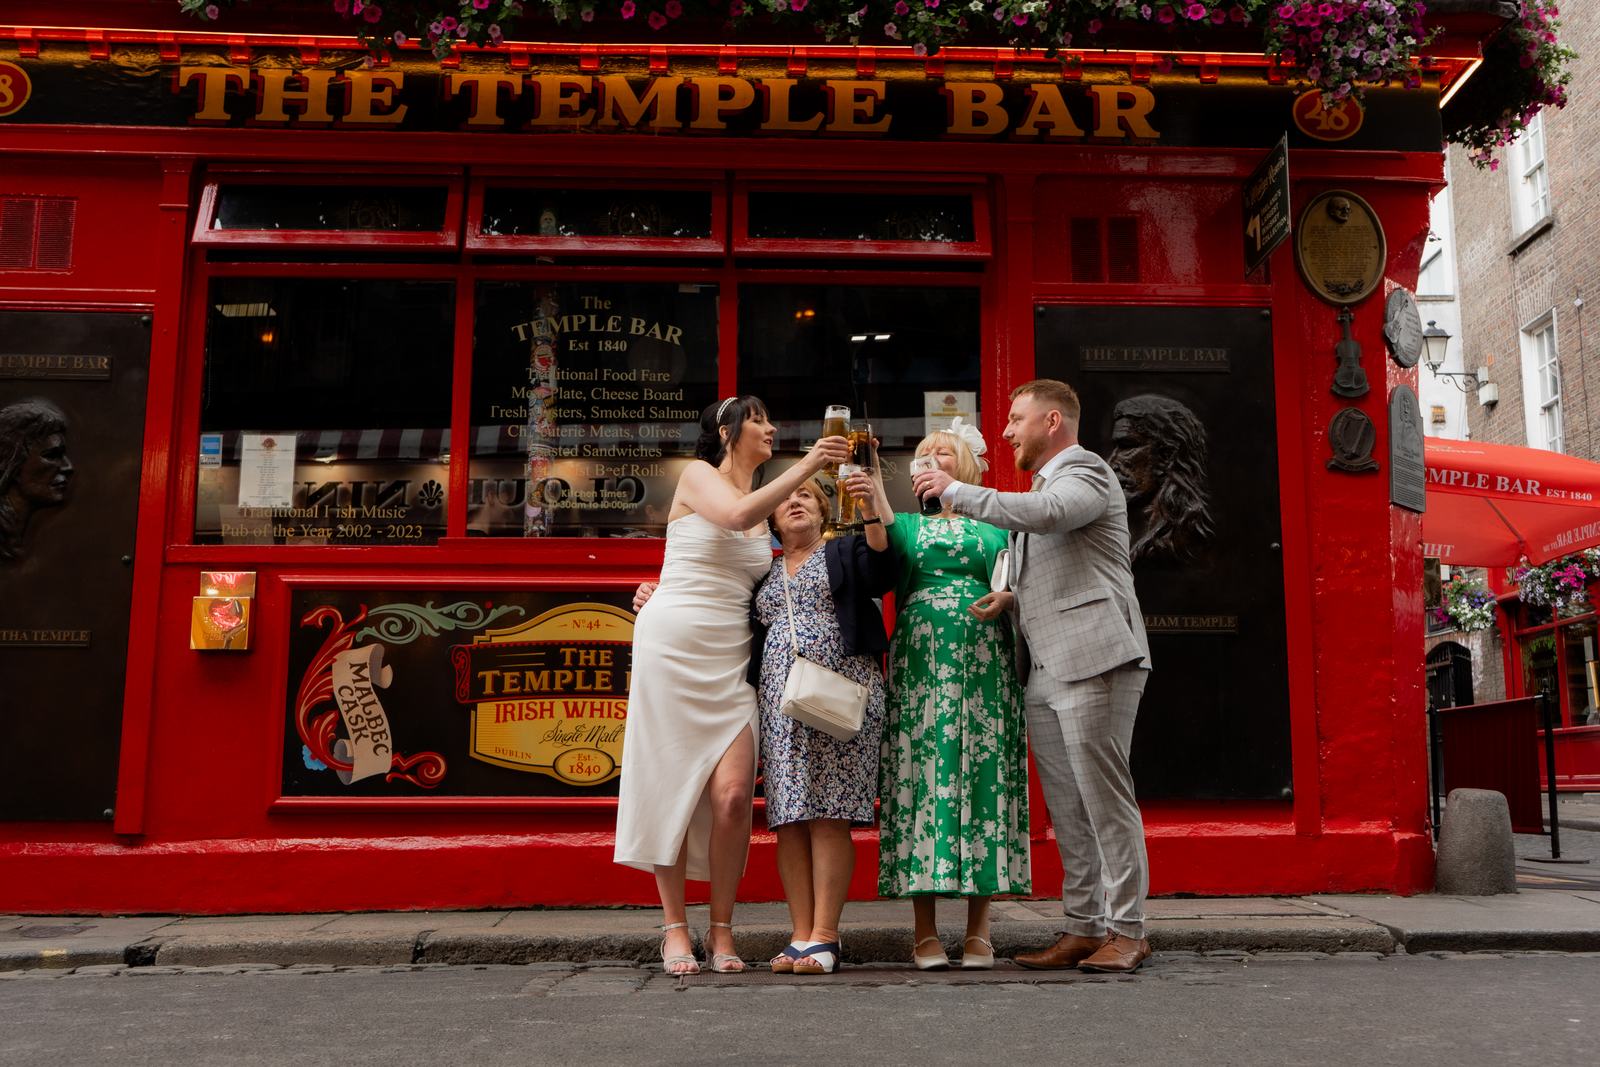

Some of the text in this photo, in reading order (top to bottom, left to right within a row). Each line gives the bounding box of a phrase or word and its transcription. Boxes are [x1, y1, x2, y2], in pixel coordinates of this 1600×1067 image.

[0, 74, 14, 107] 8
[176, 66, 1161, 139] THE TEMPLE BAR
[1304, 97, 1350, 130] 48
[581, 295, 612, 310] The
[511, 314, 684, 346] TEMPLE BAR
[568, 339, 628, 352] Est 1840
[1085, 348, 1228, 361] THE TEMPLE BAR
[73, 356, 109, 369] BAR
[525, 367, 671, 382] Titional Food Fare
[591, 387, 639, 400] Cheese
[643, 388, 684, 401] Board
[591, 406, 645, 419] Smoked
[649, 406, 700, 420] Salmon
[507, 424, 682, 439] Chcuterie Meats, Olives
[583, 444, 663, 458] Sandwiches
[630, 464, 665, 478] Rolls
[1424, 467, 1593, 501] MPLE BAR EST 1840
[599, 488, 628, 499] Times
[241, 504, 406, 519] Traditional Iish Music
[220, 524, 251, 538] Pub
[254, 524, 272, 538] of
[273, 524, 296, 538] the
[299, 524, 332, 539] Year
[336, 524, 372, 539] 2002
[386, 524, 423, 539] 2023
[1145, 616, 1236, 628] LIAM TEMPLE
[1, 630, 89, 641] THA TEMPLE
[559, 647, 614, 667] THE
[477, 670, 614, 696] TEMPLE
[338, 685, 370, 745] CASK
[349, 662, 390, 757] MALBEC
[494, 701, 628, 724] IRISH WHIS
[539, 720, 585, 747] Single
[494, 746, 533, 760] DUBLIN
[569, 762, 601, 776] 1840
